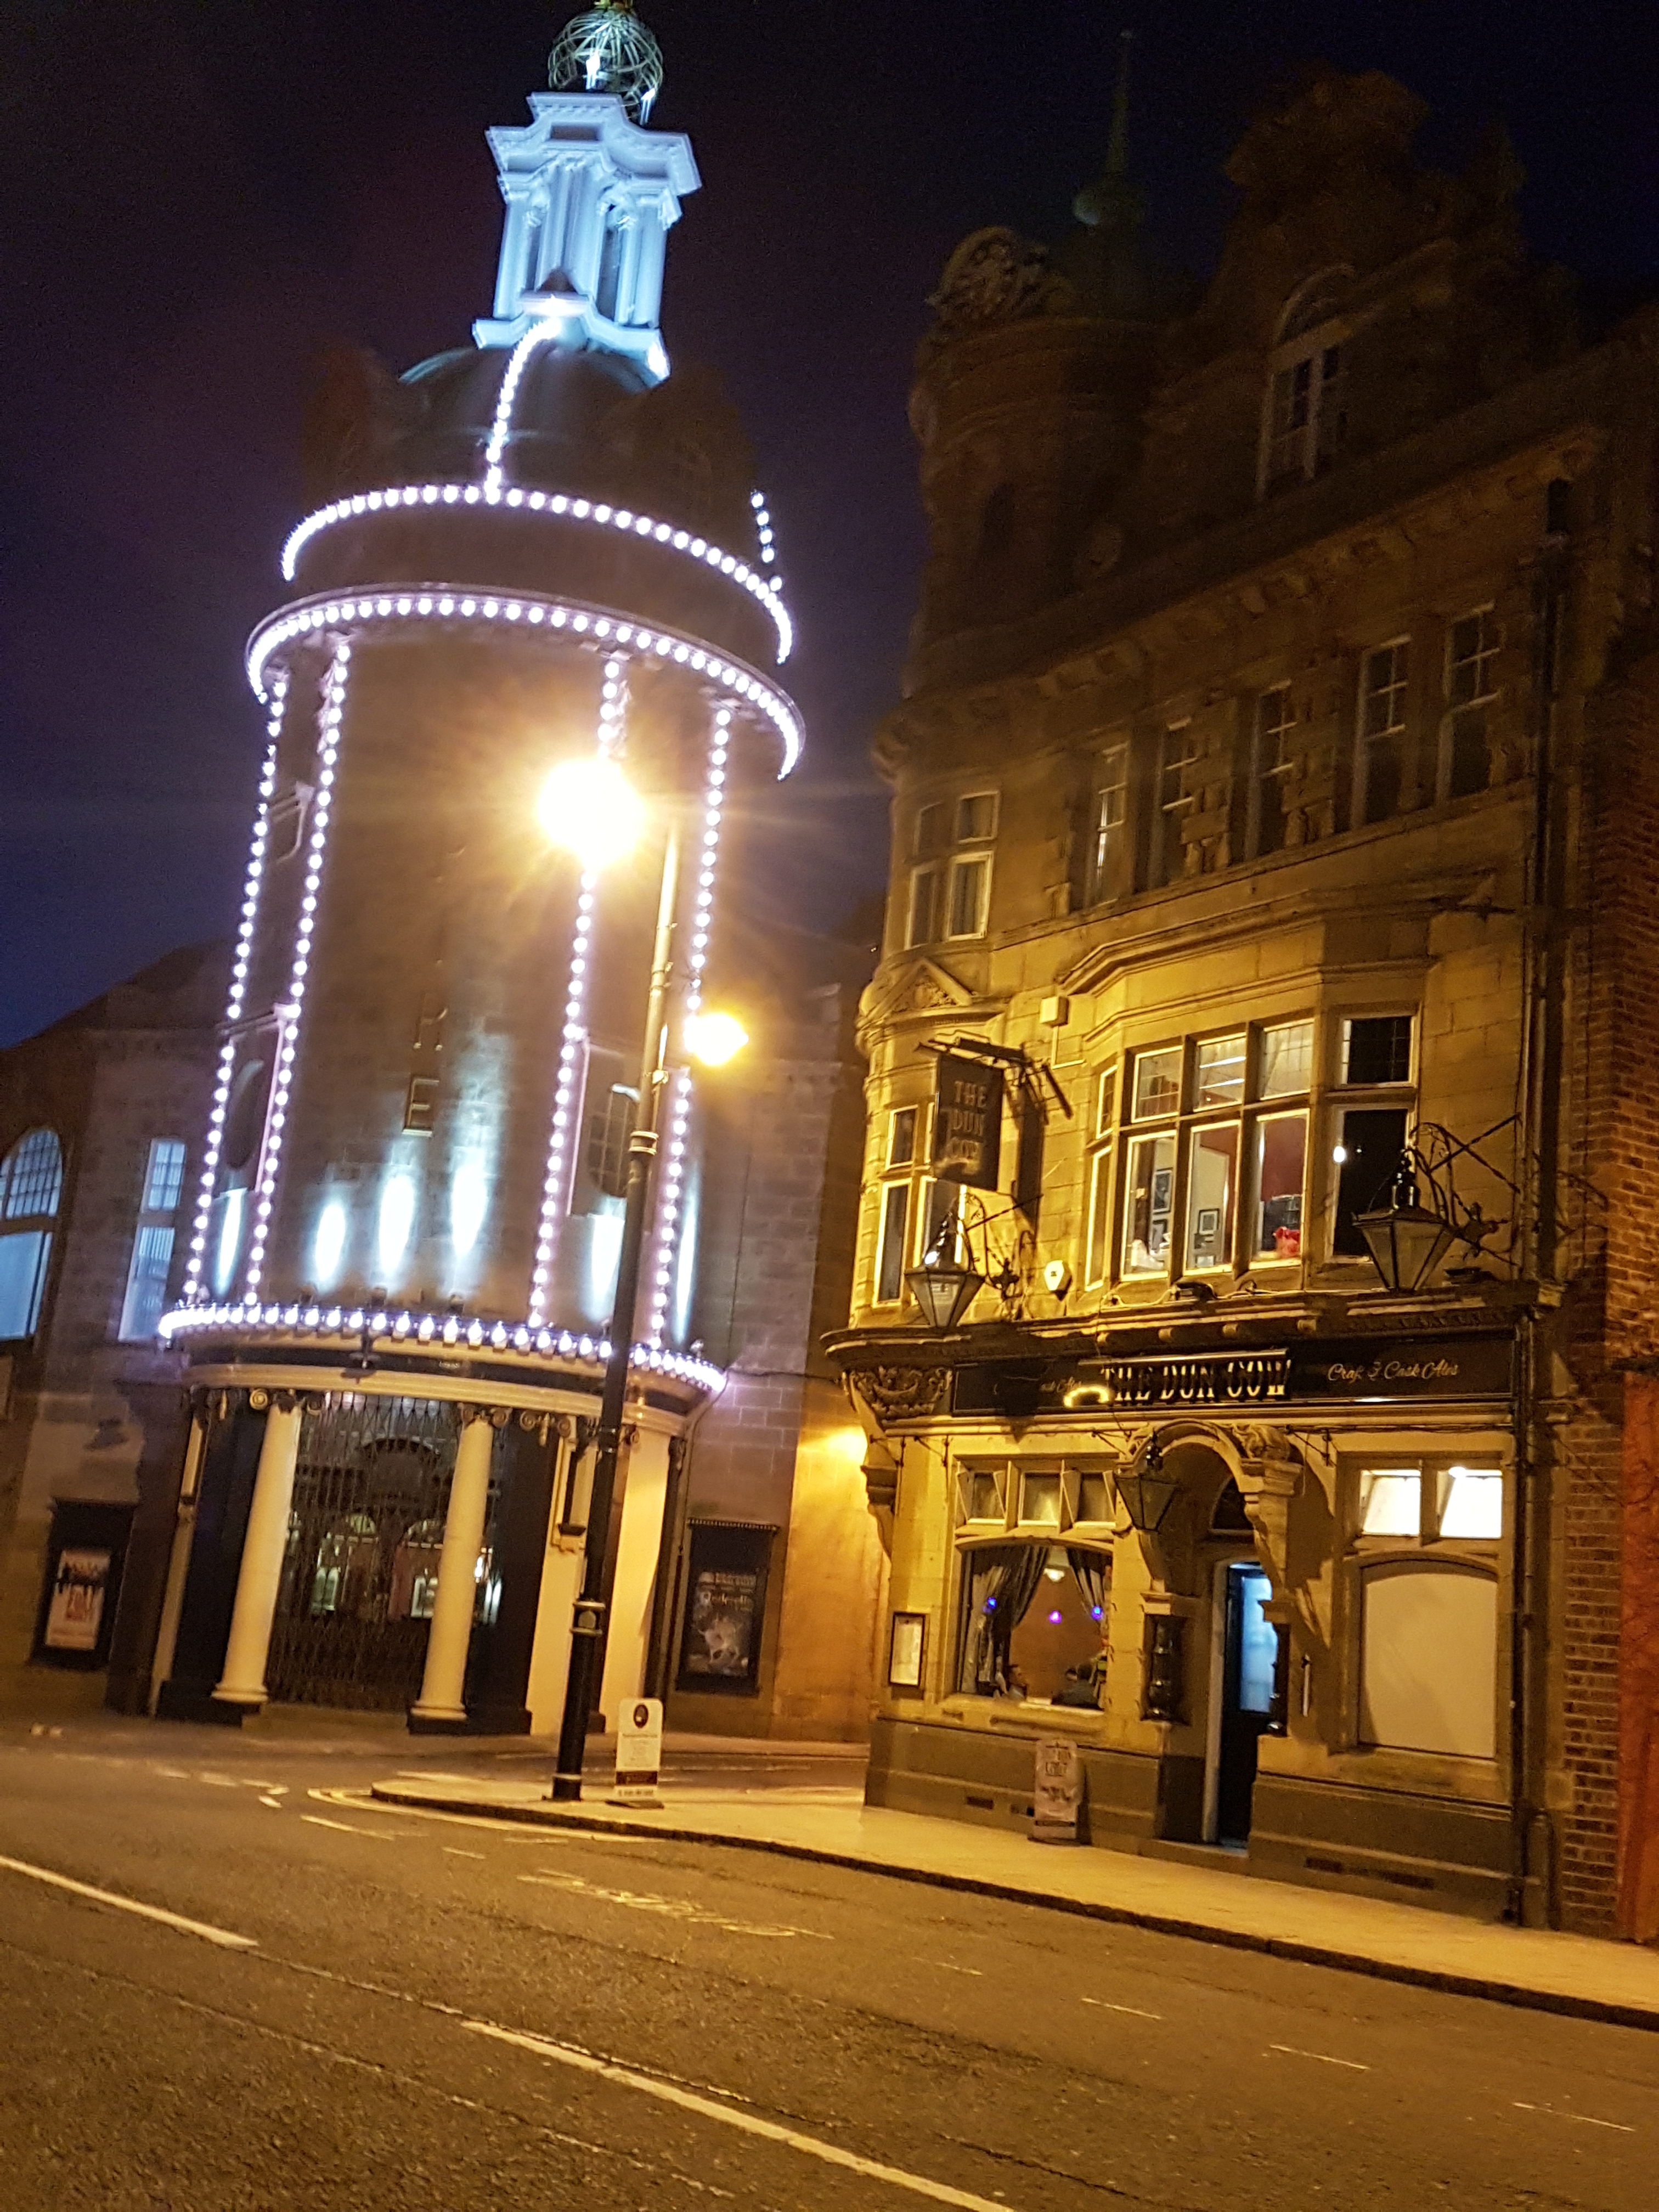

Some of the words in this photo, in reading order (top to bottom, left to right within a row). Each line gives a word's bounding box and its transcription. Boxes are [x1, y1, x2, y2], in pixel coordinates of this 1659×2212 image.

[953, 1080, 987, 1108] THE
[1100, 1366, 1153, 1401] THE
[1160, 1364, 1215, 1399] DUN
[1227, 1359, 1291, 1398] COW
[1421, 1359, 1458, 1379] Ales
